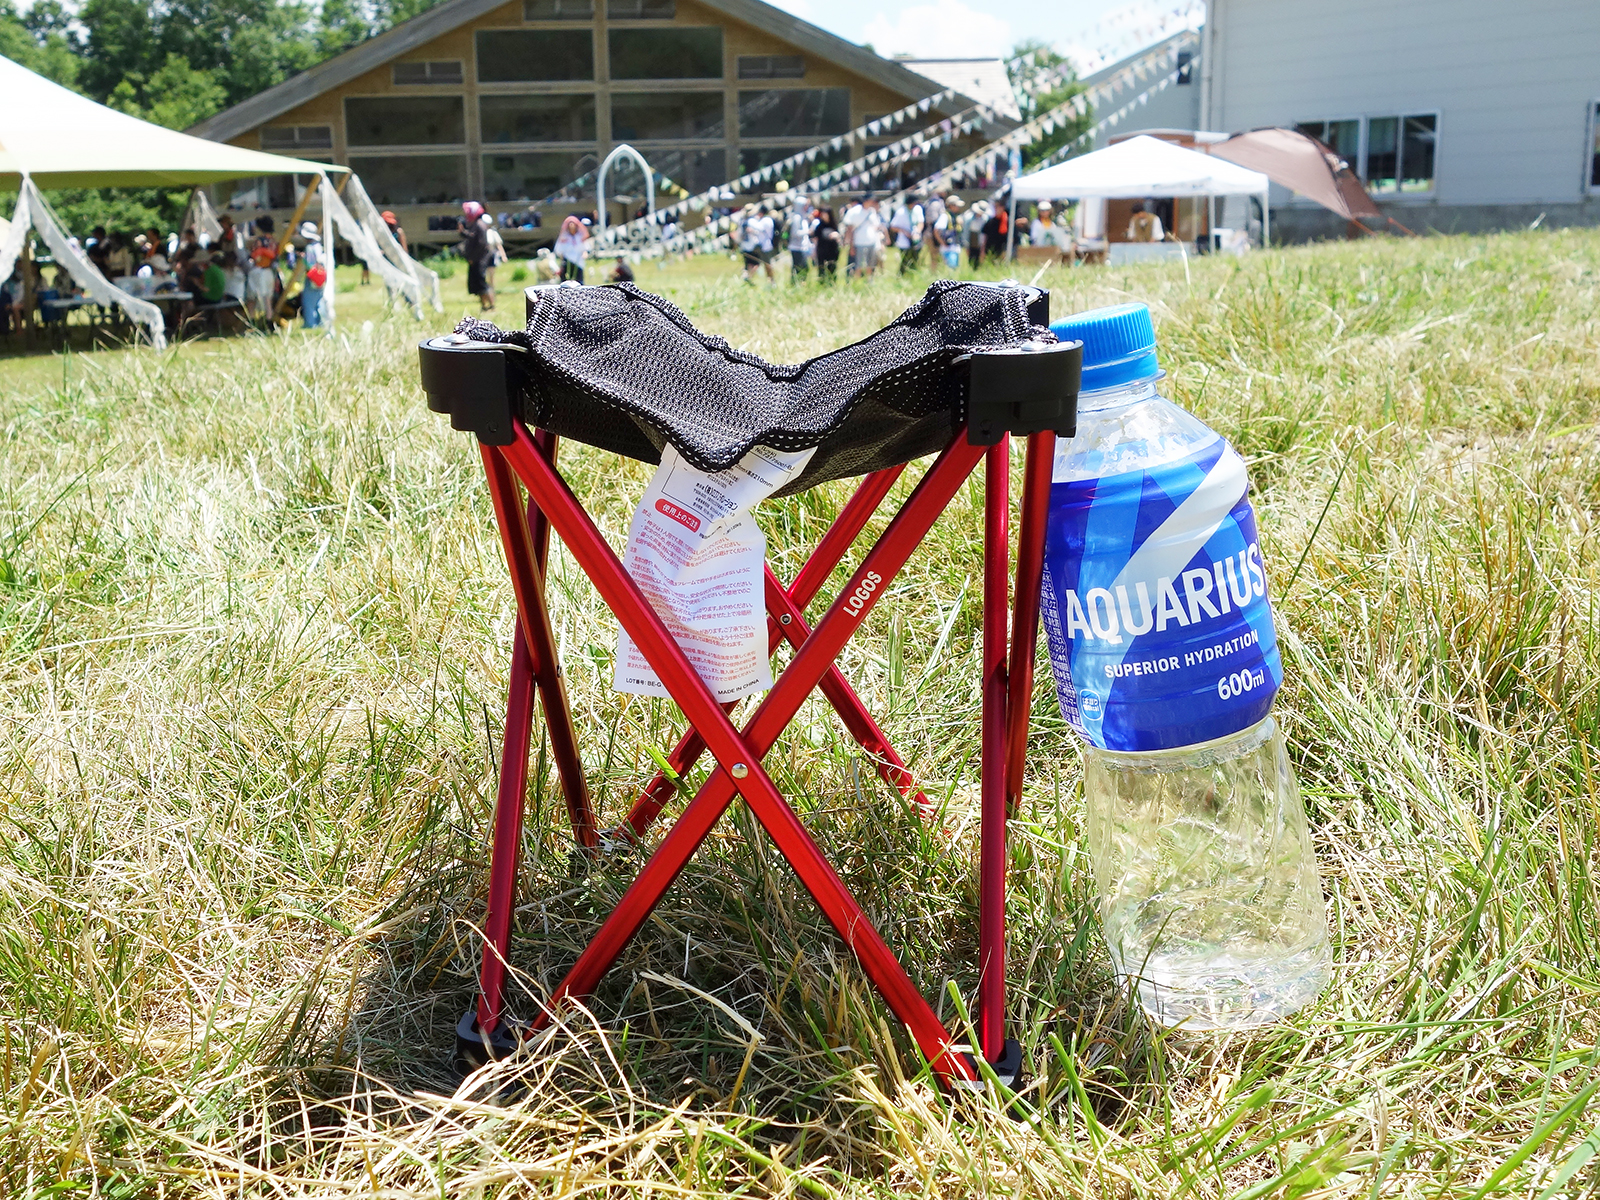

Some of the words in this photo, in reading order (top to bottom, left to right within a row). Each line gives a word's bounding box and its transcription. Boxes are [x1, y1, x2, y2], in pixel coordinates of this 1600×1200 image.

[843, 571, 882, 617] LOGOS
[1065, 542, 1265, 645] AQUARIUS
[1104, 656, 1180, 678] SUPERIOR
[1185, 629, 1259, 666] HYDRATION
[742, 678, 760, 689] CHINA
[1217, 668, 1265, 700] 600ml
